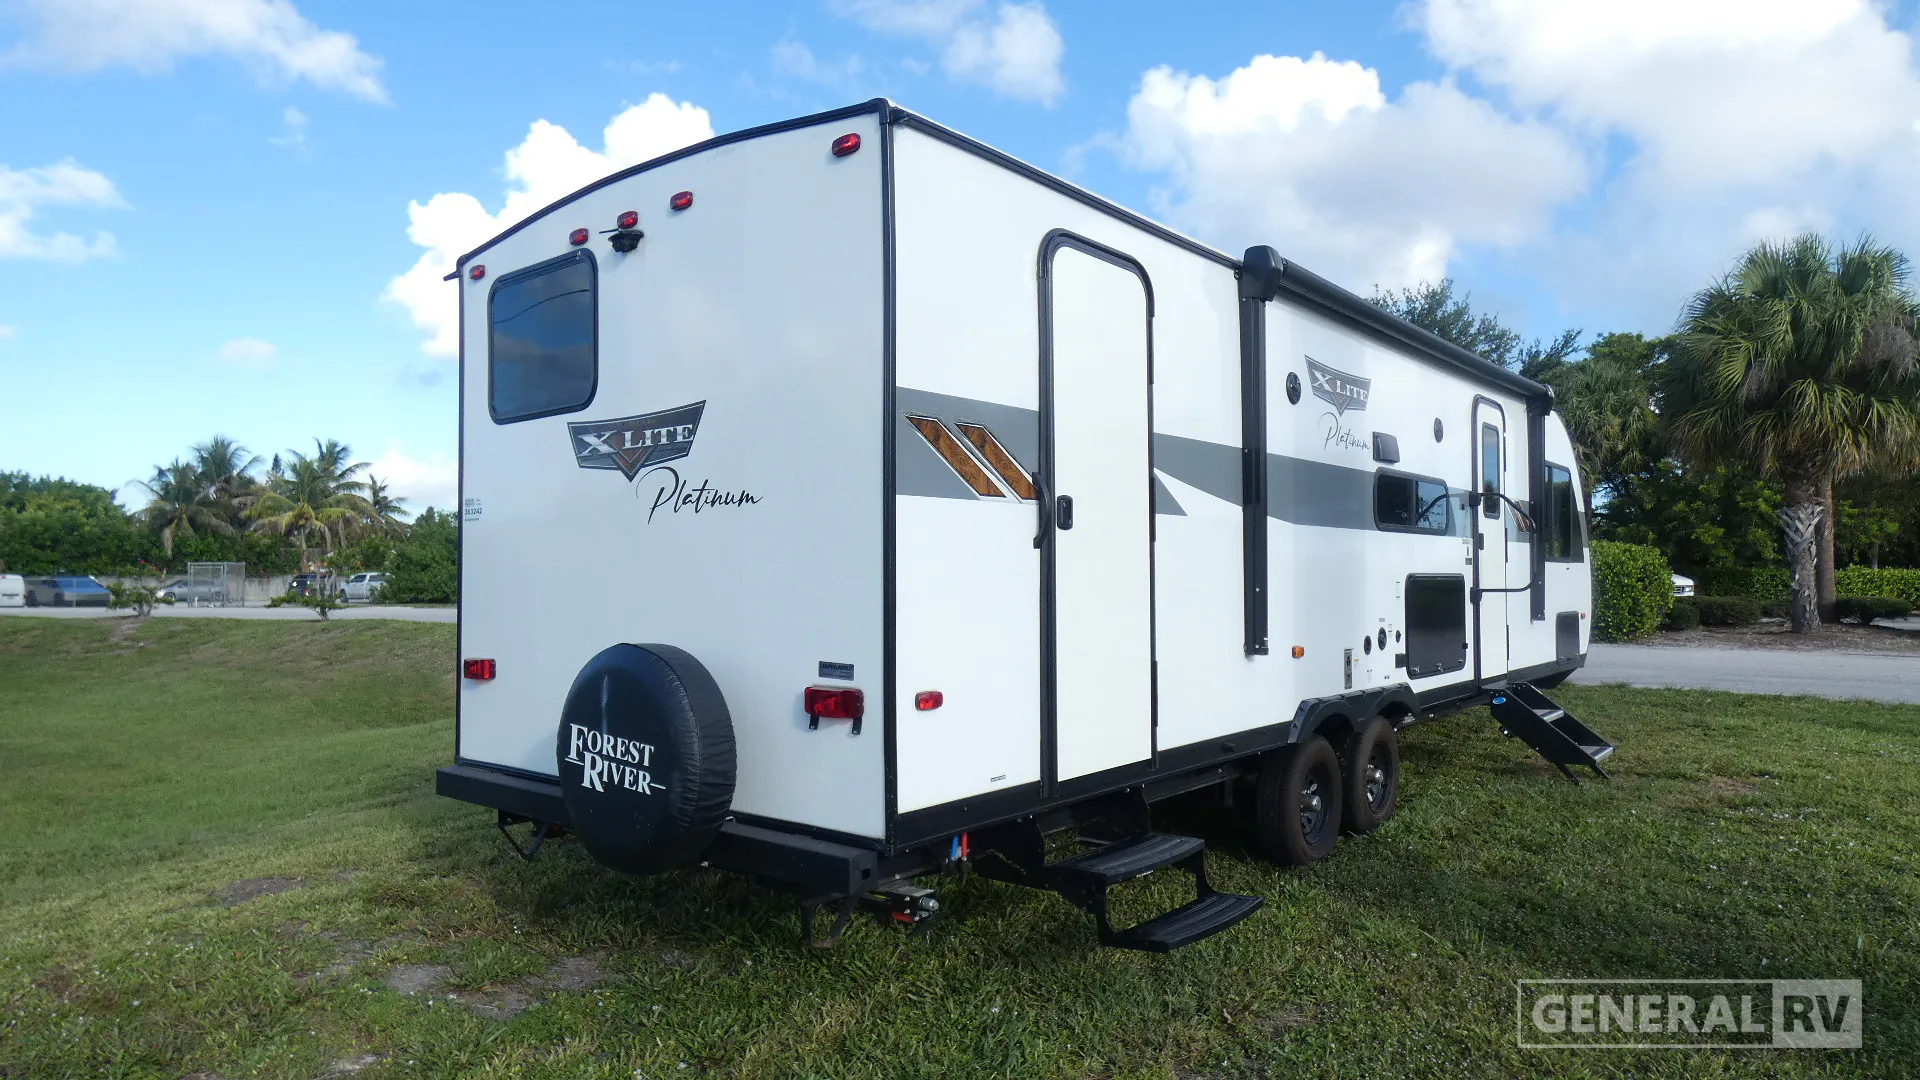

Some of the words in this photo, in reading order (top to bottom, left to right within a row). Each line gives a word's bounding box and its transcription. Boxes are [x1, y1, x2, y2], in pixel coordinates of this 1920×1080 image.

[1311, 368, 1334, 393] X
[1335, 379, 1368, 402] LITE
[577, 430, 619, 457] X
[622, 424, 695, 450] LITE
[1317, 412, 1371, 451] Platinum
[636, 466, 764, 525] Platinum
[567, 723, 655, 768] FOREST
[581, 748, 652, 796] RIVER
